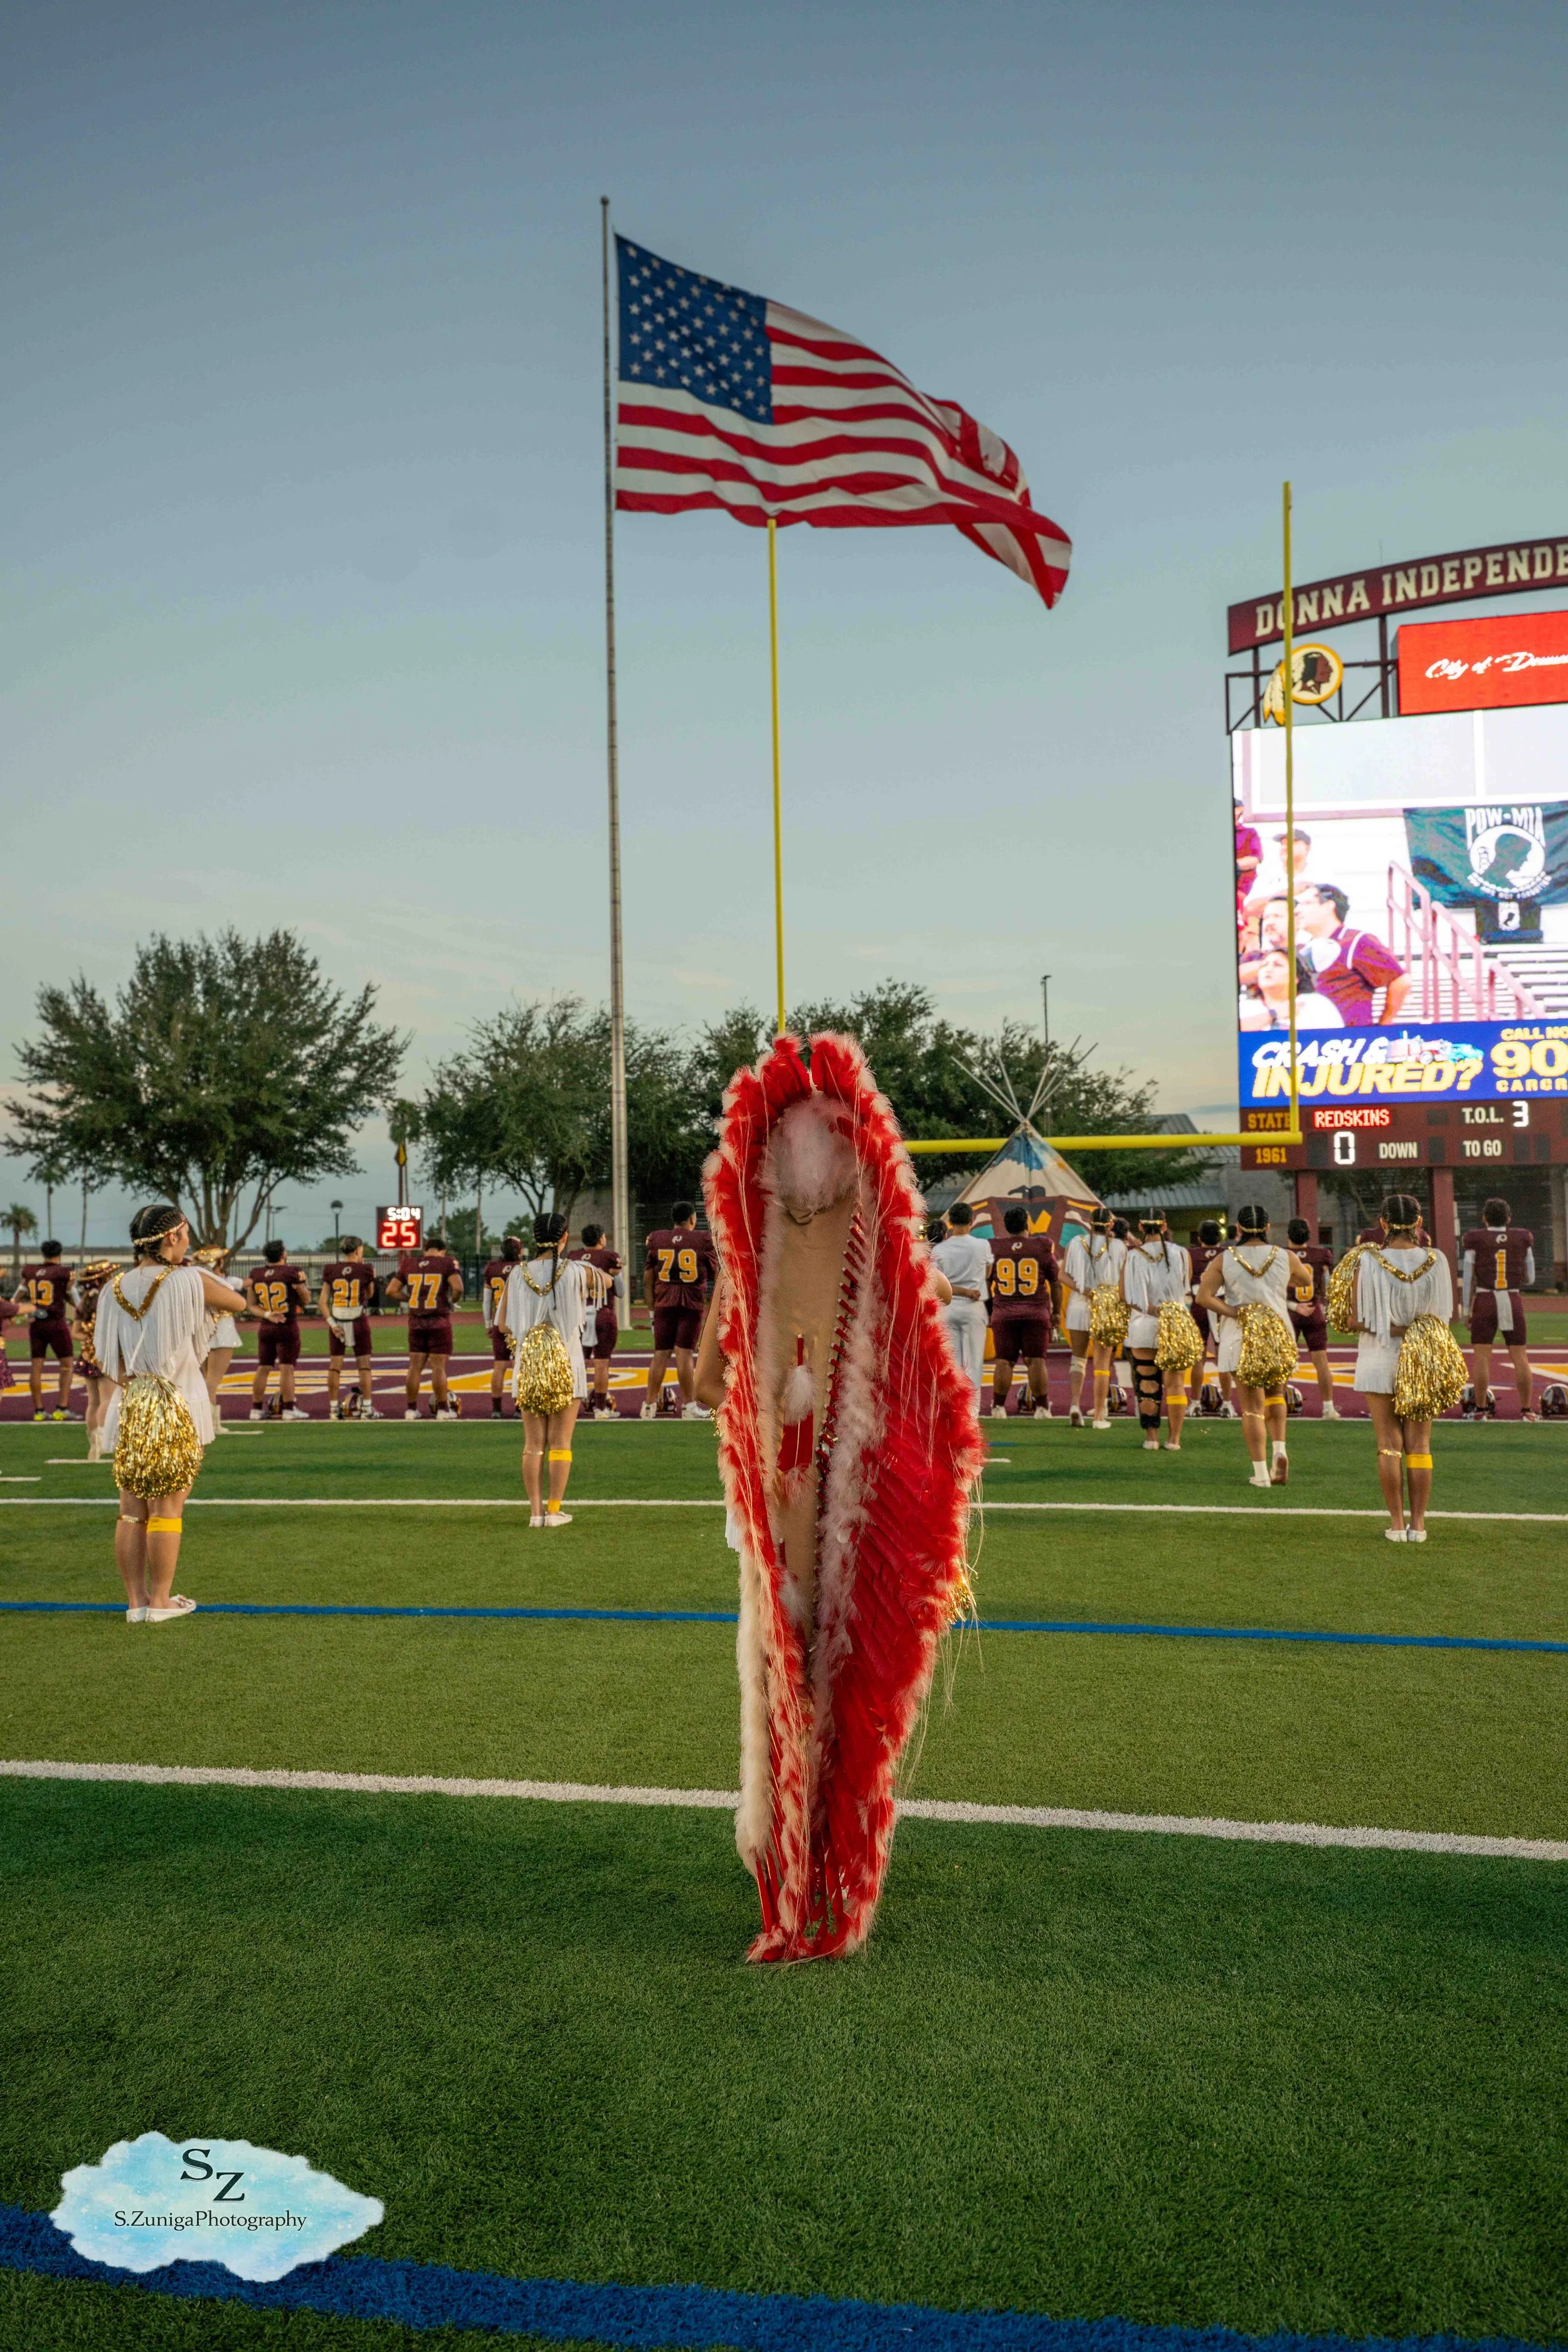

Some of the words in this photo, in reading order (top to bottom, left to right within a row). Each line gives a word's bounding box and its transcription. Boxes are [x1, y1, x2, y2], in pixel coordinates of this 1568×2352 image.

[1256, 578, 1370, 637] DONNA
[1382, 543, 1568, 605] INDEPENDE
[1425, 658, 1469, 680] City
[1471, 656, 1493, 674] of
[1500, 1027, 1545, 1041] CALL
[1252, 1039, 1366, 1067] CRASH
[1361, 1037, 1389, 1064] &
[1490, 1039, 1568, 1079] 90
[1252, 1059, 1483, 1097] INJURED?
[1248, 1113, 1291, 1129] STATE
[1314, 1108, 1391, 1128] REDSKINS
[1461, 1107, 1504, 1124] T.O.L.
[1512, 1101, 1529, 1127] 3
[1256, 1147, 1286, 1164] 1961
[1333, 1131, 1355, 1165] 0
[1379, 1142, 1418, 1160] DOWN
[1463, 1140, 1480, 1157] TO
[1483, 1139, 1502, 1157] GO
[388, 1207, 421, 1221] 5:04
[381, 1222, 417, 1247] 25
[657, 1249, 698, 1283] 79
[996, 1258, 1039, 1296] 99
[1495, 1249, 1508, 1289] 1
[28, 1279, 54, 1306] 13
[254, 1281, 289, 1313] 32
[332, 1278, 360, 1308] 21
[408, 1273, 442, 1309] 77
